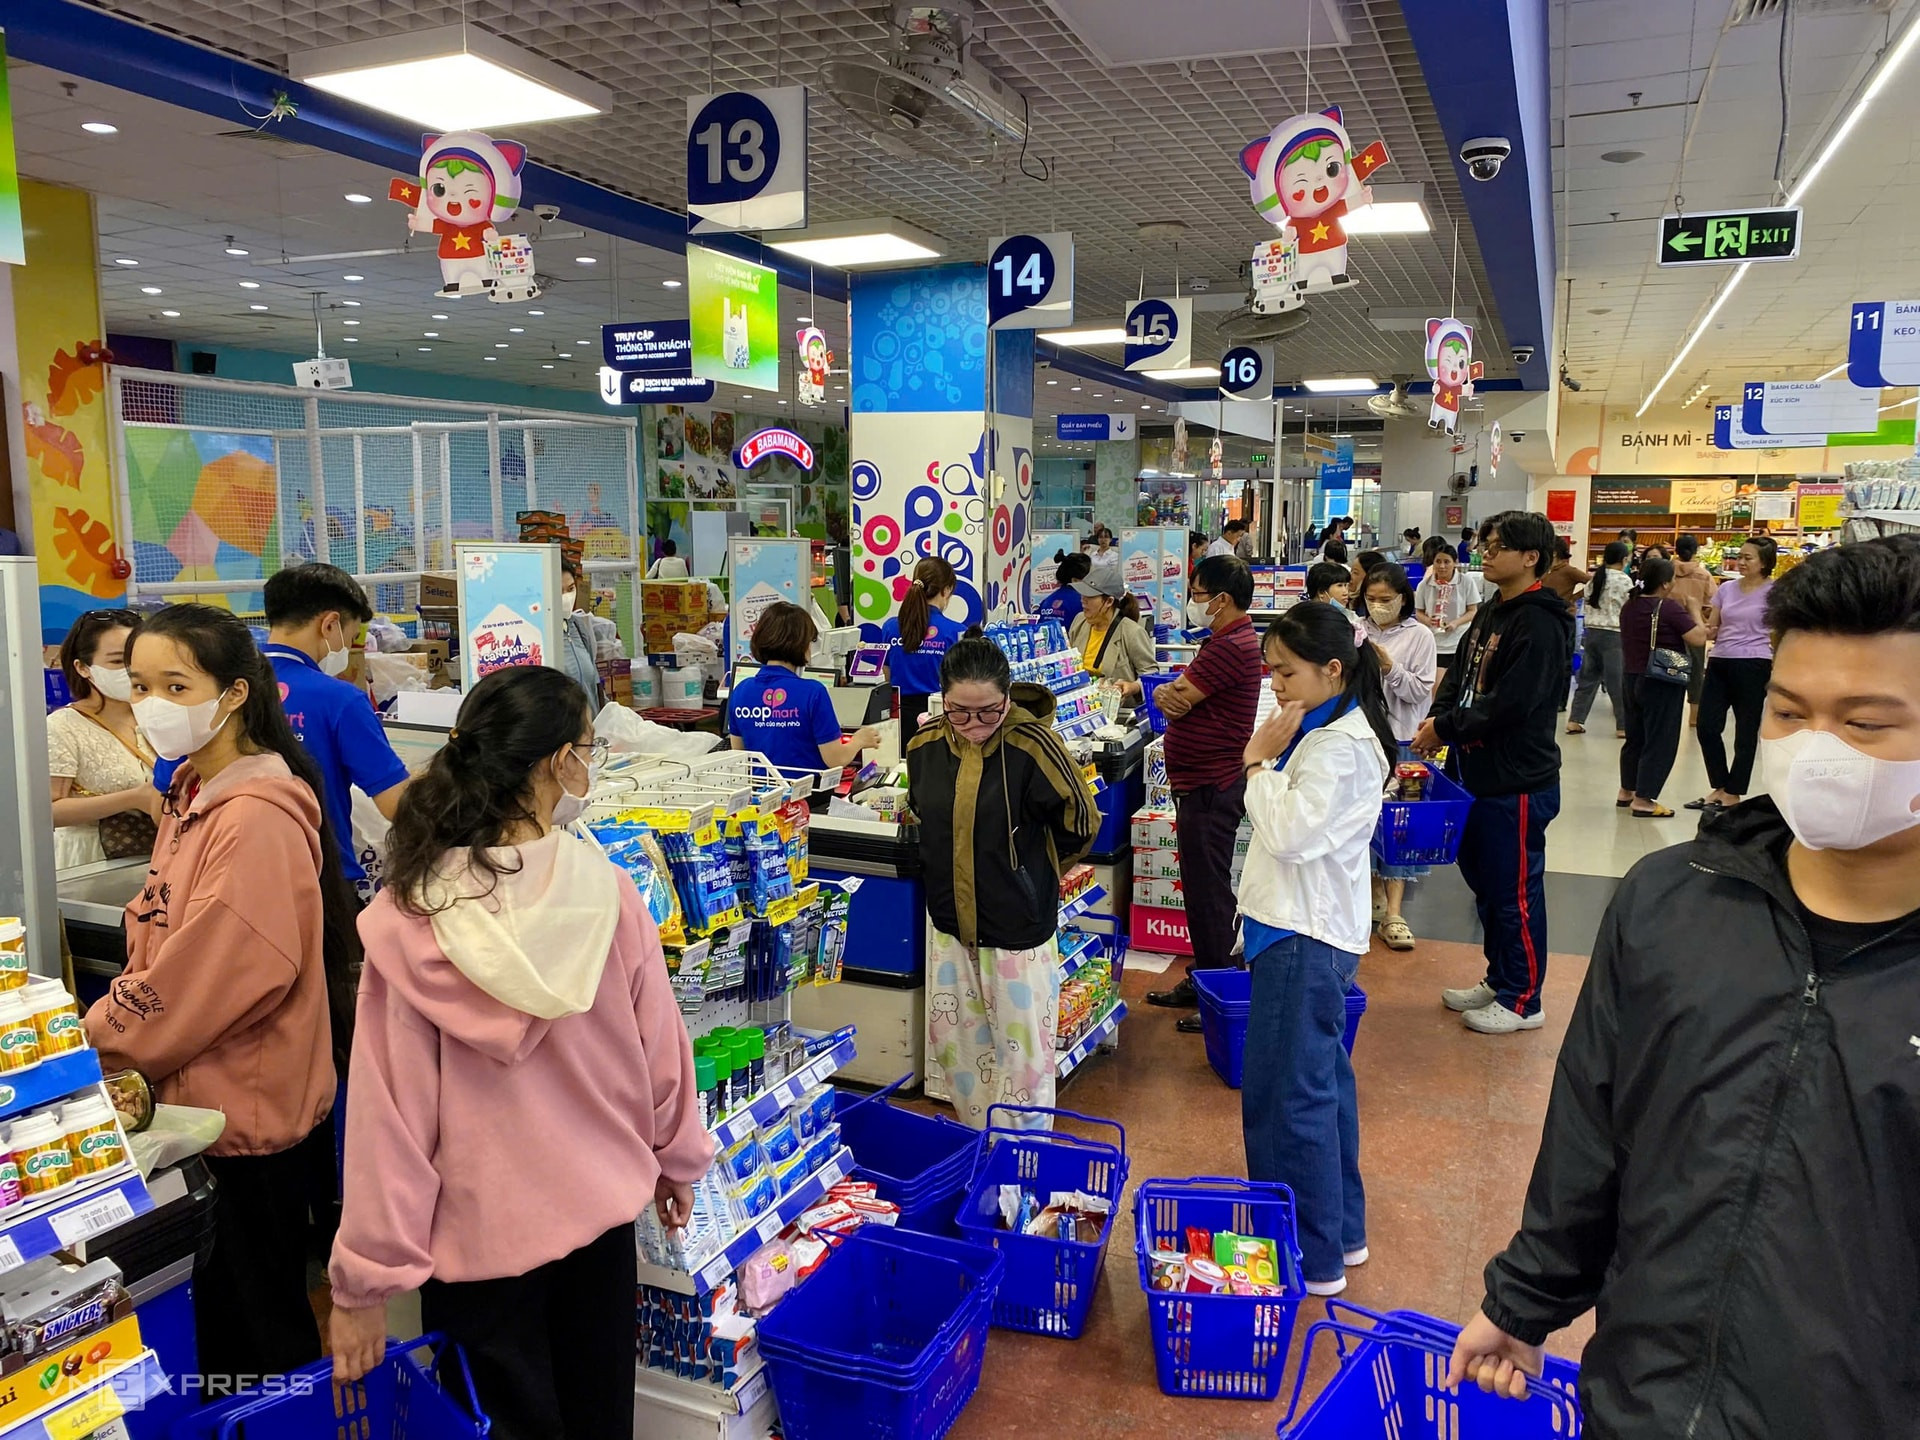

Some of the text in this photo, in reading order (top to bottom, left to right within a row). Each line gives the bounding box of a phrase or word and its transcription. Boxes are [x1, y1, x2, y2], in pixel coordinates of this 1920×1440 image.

[695, 118, 766, 184] 13
[1750, 227, 1791, 244] EXIT
[994, 252, 1045, 297] 14
[1896, 304, 1920, 314] BÁN
[1130, 313, 1171, 345] 15
[1853, 311, 1880, 331] 11
[614, 332, 636, 342] TRUY
[615, 339, 687, 353] THÔNG TIN KHÁCH
[1224, 357, 1257, 383] 16
[1746, 387, 1764, 400] 12
[1716, 409, 1731, 421] 13
[757, 433, 799, 454] BABAMAMA
[1621, 431, 1668, 448] BÁNH
[1673, 430, 1691, 446] MÌ
[425, 585, 454, 598] Select
[754, 719, 801, 729] bạn của mọi nhà
[697, 865, 732, 884] Gillette
[733, 906, 740, 918] 6
[44, 1301, 103, 1341] SNICKERS
[71, 1413, 89, 1429] 44
